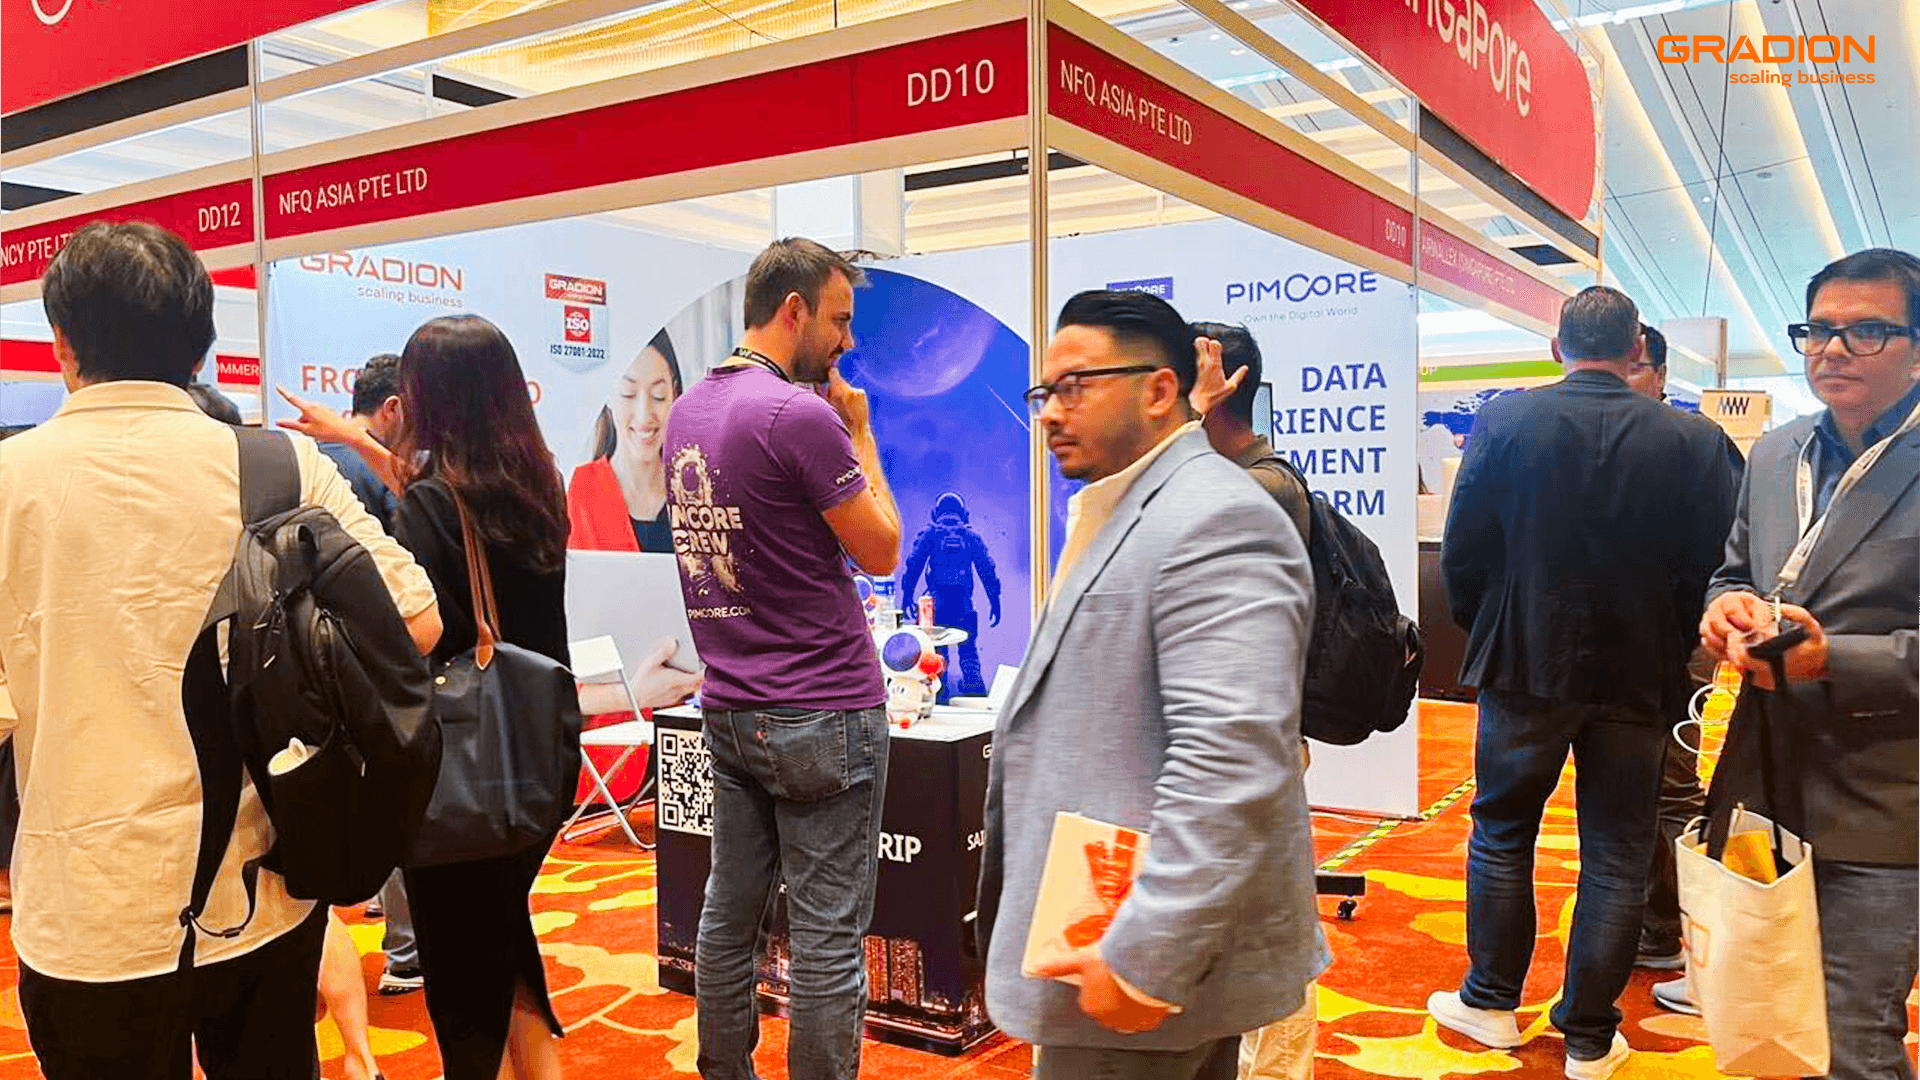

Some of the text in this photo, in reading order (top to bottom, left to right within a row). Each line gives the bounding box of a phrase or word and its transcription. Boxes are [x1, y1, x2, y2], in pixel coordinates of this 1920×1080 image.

[907, 59, 994, 107] DD10
[1060, 60, 1193, 145] NFQ ASIA PTE LTD
[279, 167, 428, 215] NFQ ASIA PTE LTD
[198, 202, 241, 232] DD12
[28, 238, 53, 261] PTE
[55, 231, 73, 257] LT
[357, 286, 463, 308] scaling business
[549, 279, 602, 295] GRADION
[1226, 271, 1378, 305] PIMCORE
[566, 317, 589, 331] ISO
[1243, 306, 1359, 324] Own the Digital World
[550, 344, 562, 355] ISO
[216, 361, 262, 377] MMER
[1302, 363, 1387, 393] DATA
[1272, 404, 1386, 435] RIENCE
[1275, 447, 1387, 475] MENT
[673, 529, 731, 555] CREW
[877, 831, 922, 863] RIP
